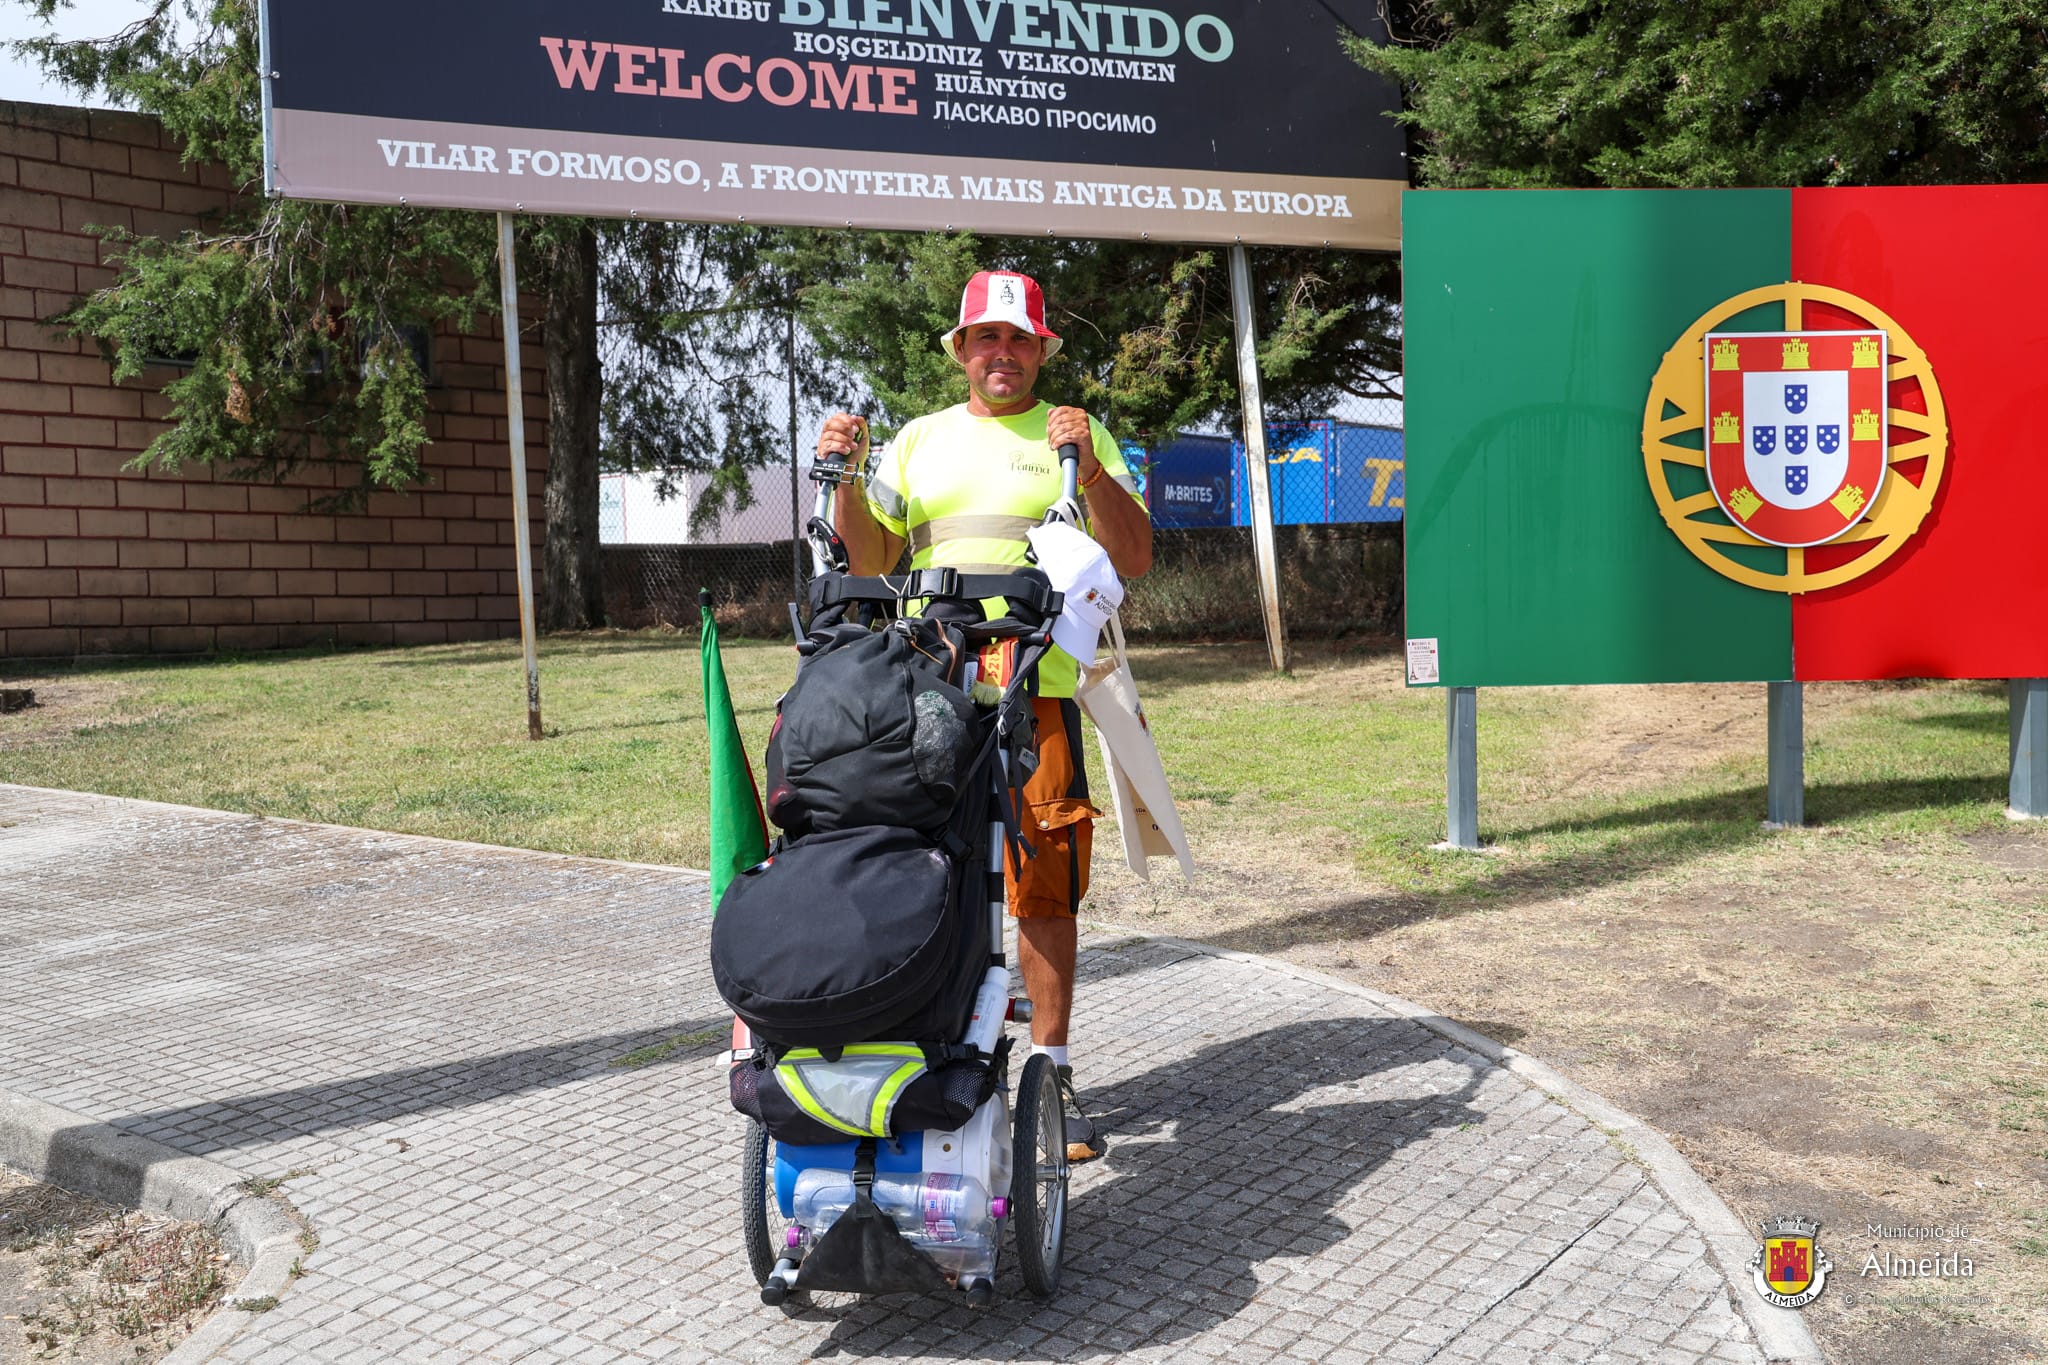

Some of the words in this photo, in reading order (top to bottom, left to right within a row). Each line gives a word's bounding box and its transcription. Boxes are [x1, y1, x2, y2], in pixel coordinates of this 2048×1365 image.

[662, 0, 771, 22] KARIBU
[779, 0, 1234, 63] BIENVENIDO
[793, 31, 983, 67] HOŞGELDINIZ
[539, 36, 918, 116] WELCOME
[998, 49, 1177, 83] VELKOMMEN
[935, 70, 1067, 101] HUĀNYÍNG
[933, 101, 1040, 127] ЛАСКАВО
[1046, 108, 1157, 134] ПРОСИМО
[377, 139, 499, 174] VILAR
[507, 148, 711, 192] FORMOSO,
[718, 162, 744, 189] A
[750, 164, 954, 200] FRONTEIRA
[960, 176, 1044, 204] MAIS
[1053, 181, 1177, 210] ANTIGA
[1181, 187, 1228, 213] DA
[1232, 189, 1353, 218] EUROPA
